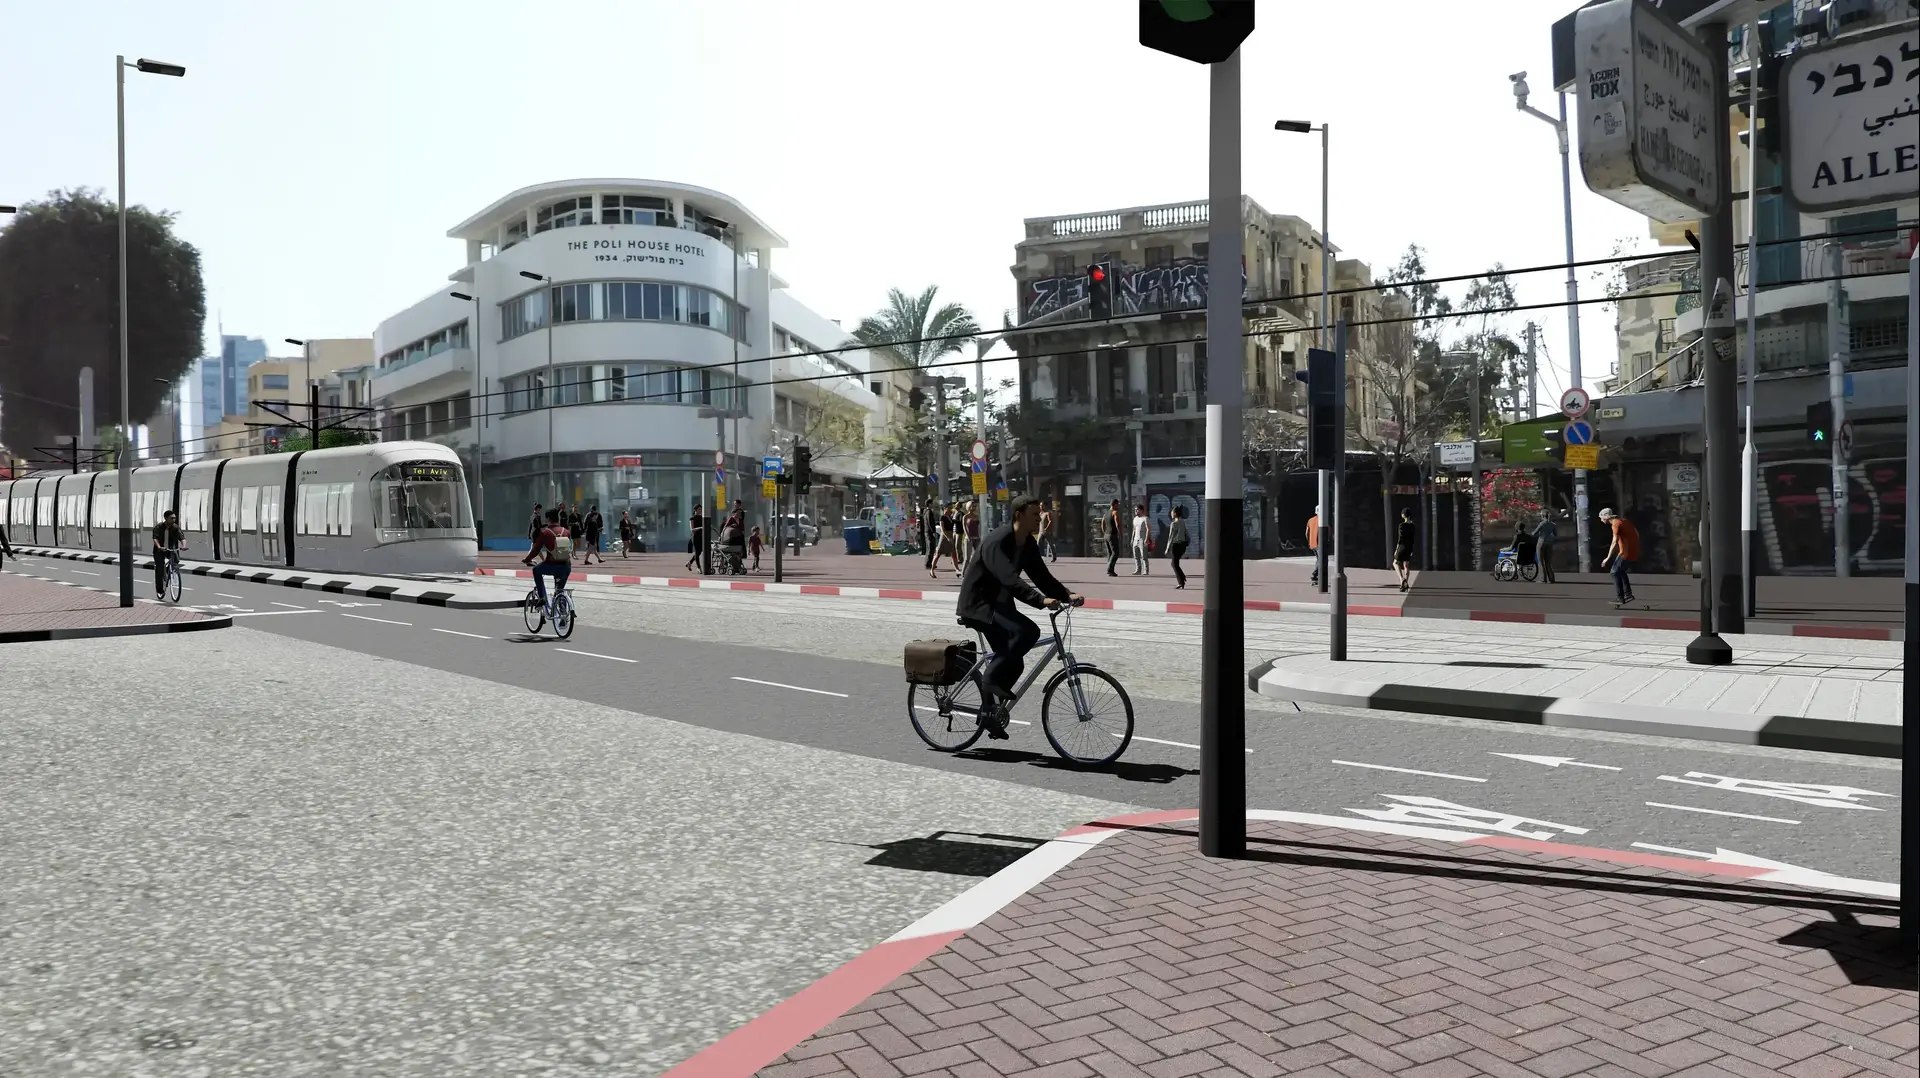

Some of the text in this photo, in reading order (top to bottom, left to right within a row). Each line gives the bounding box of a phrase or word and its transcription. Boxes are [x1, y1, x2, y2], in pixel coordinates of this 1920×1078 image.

[567, 239, 705, 257] THE POLI HOUSE HOTEL
[594, 254, 618, 262] 1934
[668, 256, 684, 265] בית
